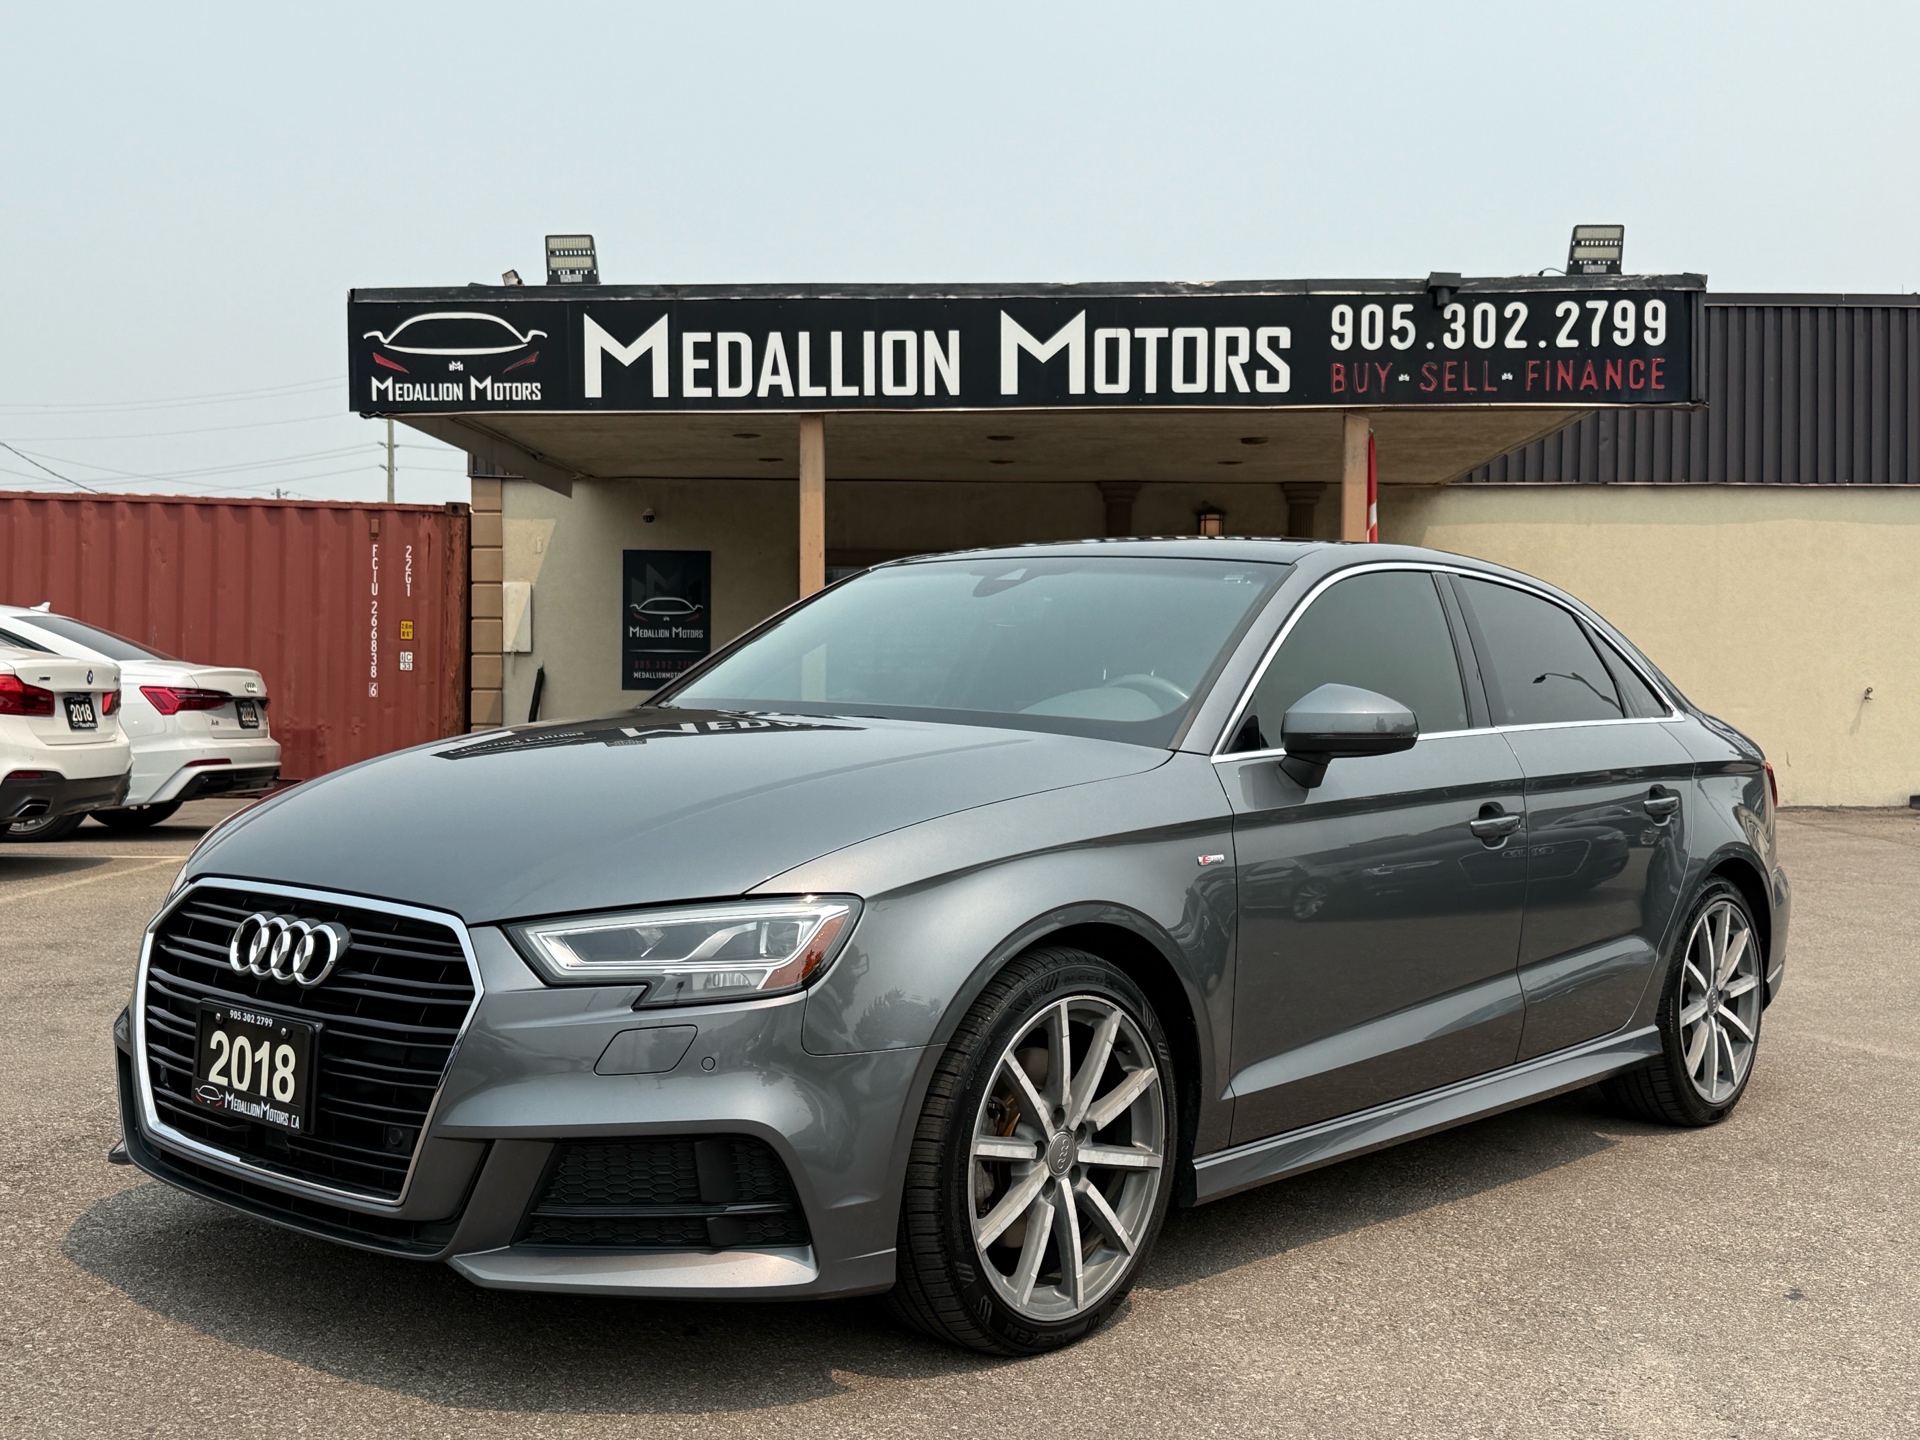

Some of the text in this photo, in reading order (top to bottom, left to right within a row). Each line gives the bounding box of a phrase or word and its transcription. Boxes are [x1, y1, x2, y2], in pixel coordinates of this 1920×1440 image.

[1330, 299, 1667, 351] 905.302.2799
[583, 309, 1291, 399] MEDALLION MOTORS
[1330, 357, 1667, 394] BUY SELL FINANCE
[371, 375, 541, 402] MEDALLION MOTORS
[371, 543, 379, 596] FCIU
[370, 600, 378, 679] 266838
[629, 625, 704, 639] MEDALLION MOTORS
[69, 703, 94, 722] 2018
[229, 1009, 273, 1027] 905 302 2799
[208, 1030, 296, 1104] 2018
